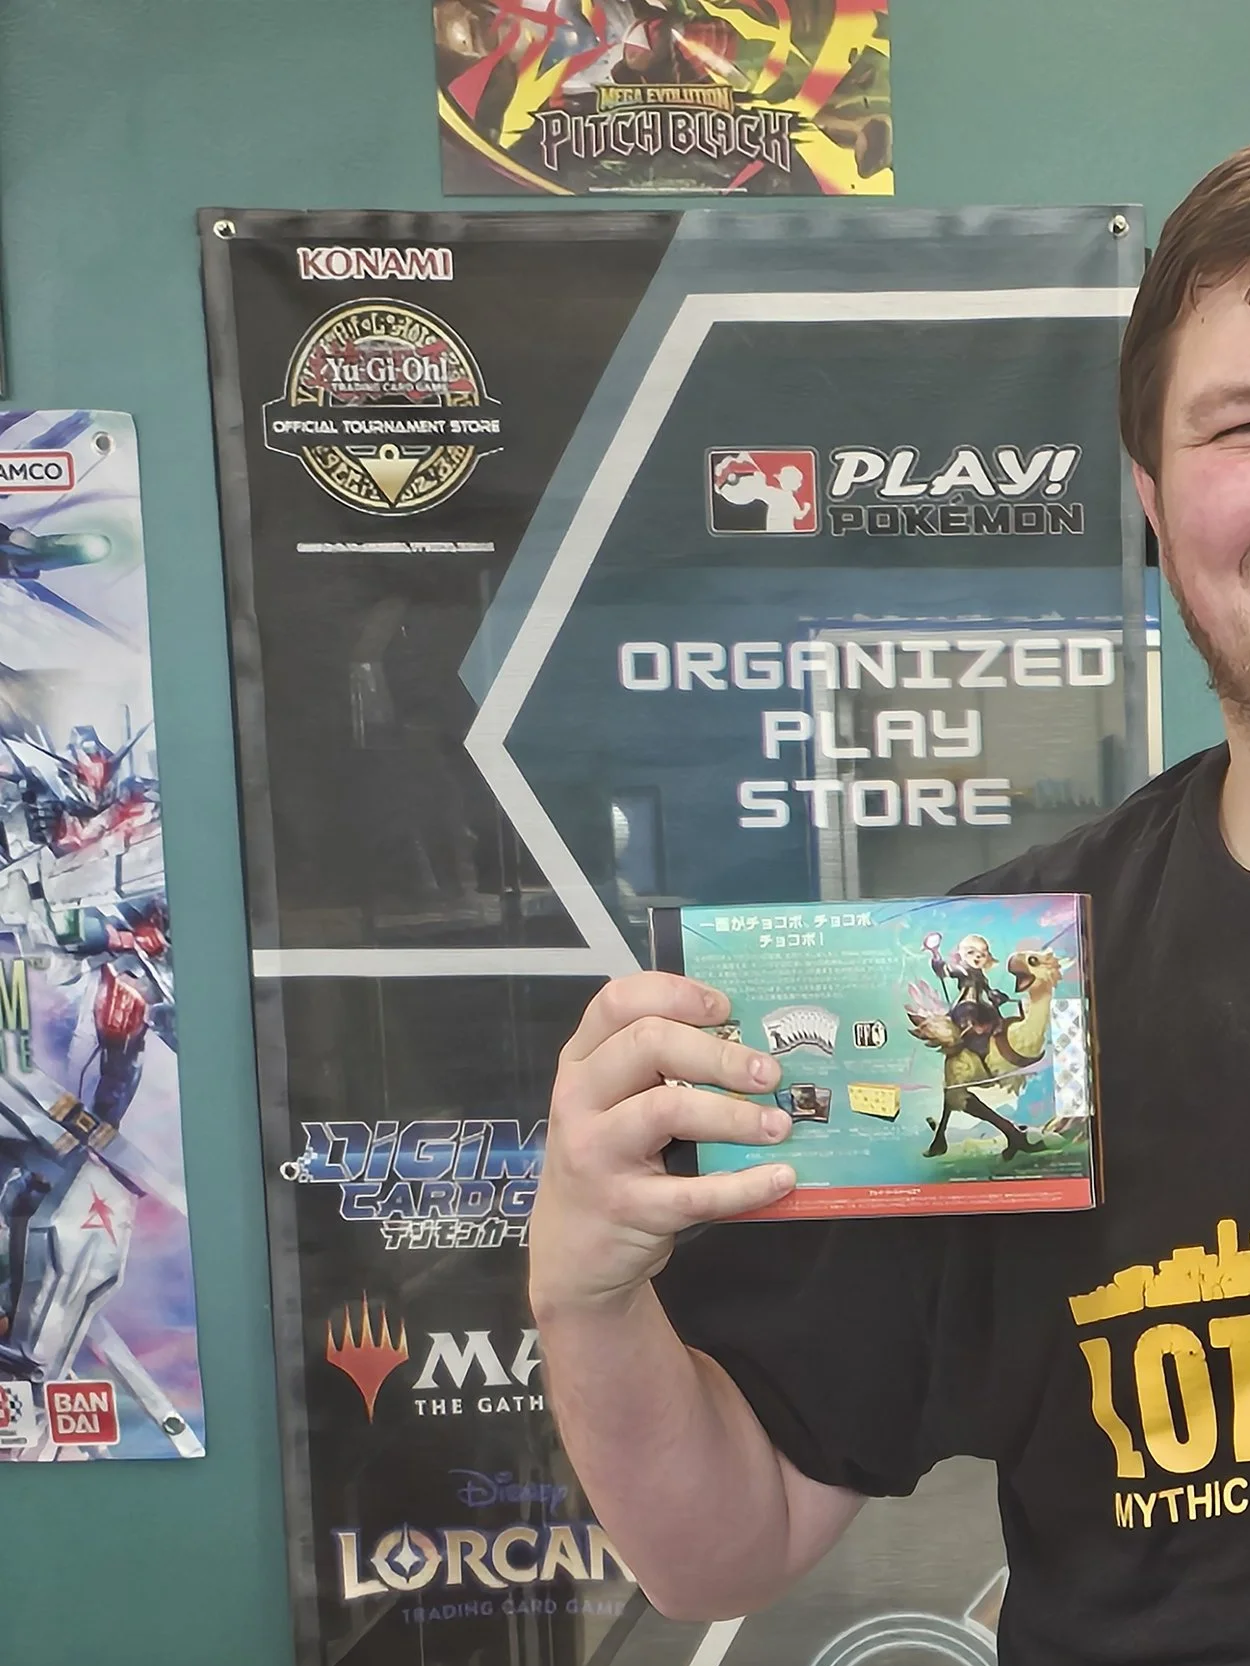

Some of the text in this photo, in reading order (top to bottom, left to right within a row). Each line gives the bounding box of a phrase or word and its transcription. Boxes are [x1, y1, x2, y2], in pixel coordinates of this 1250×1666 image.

[600, 86, 732, 109] MEGA EVOLUTION
[534, 109, 794, 172] PITCH BLACK
[300, 249, 452, 279] KONAMI
[272, 419, 500, 434] OFFICIAL TOURNAMENT STORE
[830, 447, 1080, 497] PLAY!
[829, 496, 1084, 537] POKÉMON
[619, 638, 1116, 691] ORGANIZED
[762, 709, 983, 759] PLAY
[738, 778, 1012, 828] STORE
[340, 1182, 497, 1221] CARD
[54, 1392, 108, 1412] BAN
[414, 1398, 462, 1415] THE
[57, 1413, 100, 1434] DAI
[448, 1468, 568, 1517] Disney
[1115, 1475, 1249, 1528] MYTHIC
[402, 1602, 493, 1625] TRADING
[502, 1599, 557, 1616] CARD
